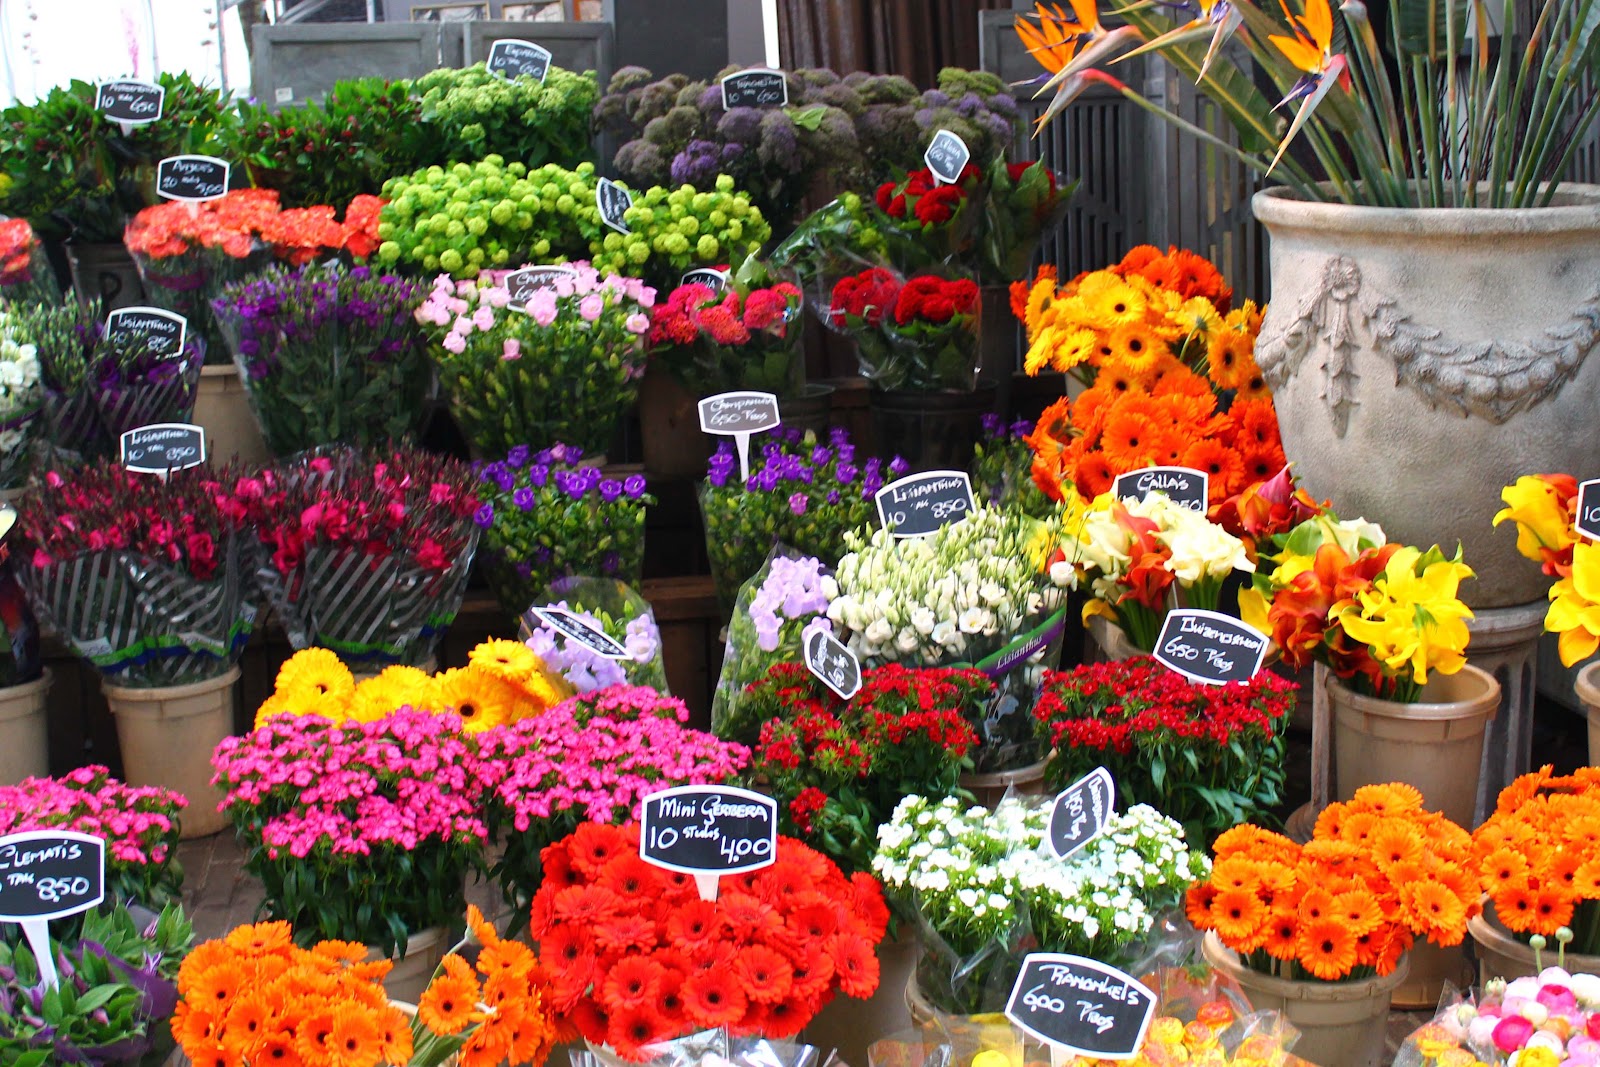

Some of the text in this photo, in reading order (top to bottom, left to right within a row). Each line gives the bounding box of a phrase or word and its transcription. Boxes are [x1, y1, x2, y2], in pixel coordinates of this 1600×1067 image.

[101, 95, 114, 108] 10
[728, 93, 739, 103] 10
[128, 449, 144, 461] 10
[888, 511, 906, 525] 10
[996, 634, 1043, 669] Lisianthus
[1165, 636, 1199, 660] 6,50
[659, 797, 696, 818] Mini
[650, 826, 678, 850] 10
[1023, 984, 1065, 1013] 6,00
